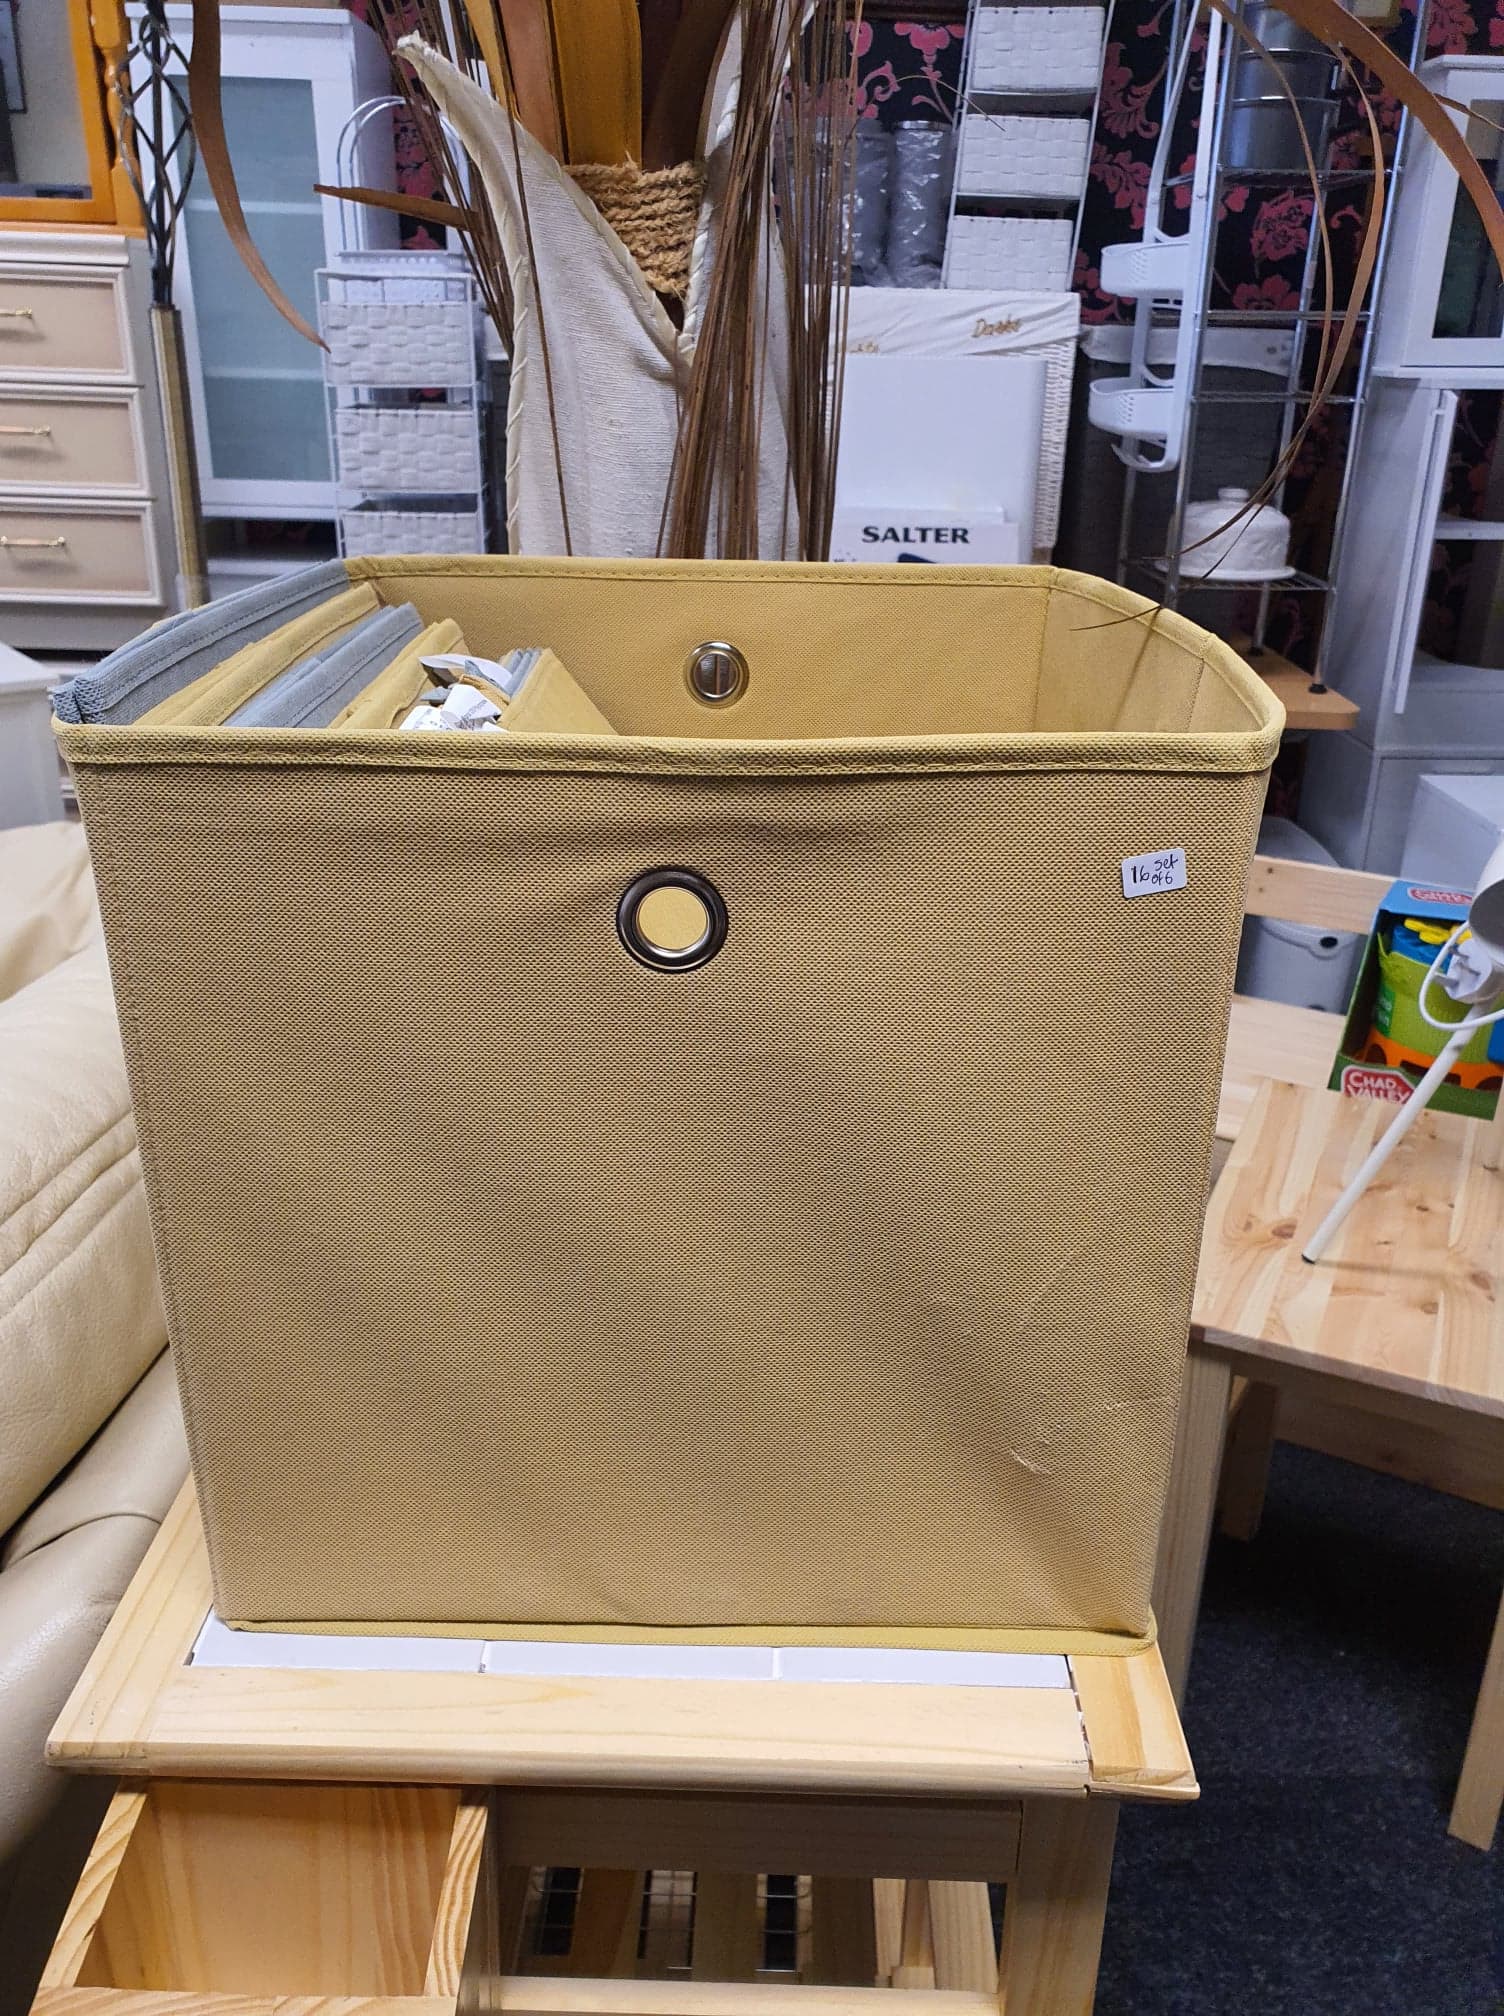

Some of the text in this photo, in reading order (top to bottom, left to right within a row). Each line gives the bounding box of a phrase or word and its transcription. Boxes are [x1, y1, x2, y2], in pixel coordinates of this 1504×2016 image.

[862, 526, 970, 544] SALTER
[1154, 853, 1179, 871] set
[1349, 1071, 1397, 1089] CHAD
